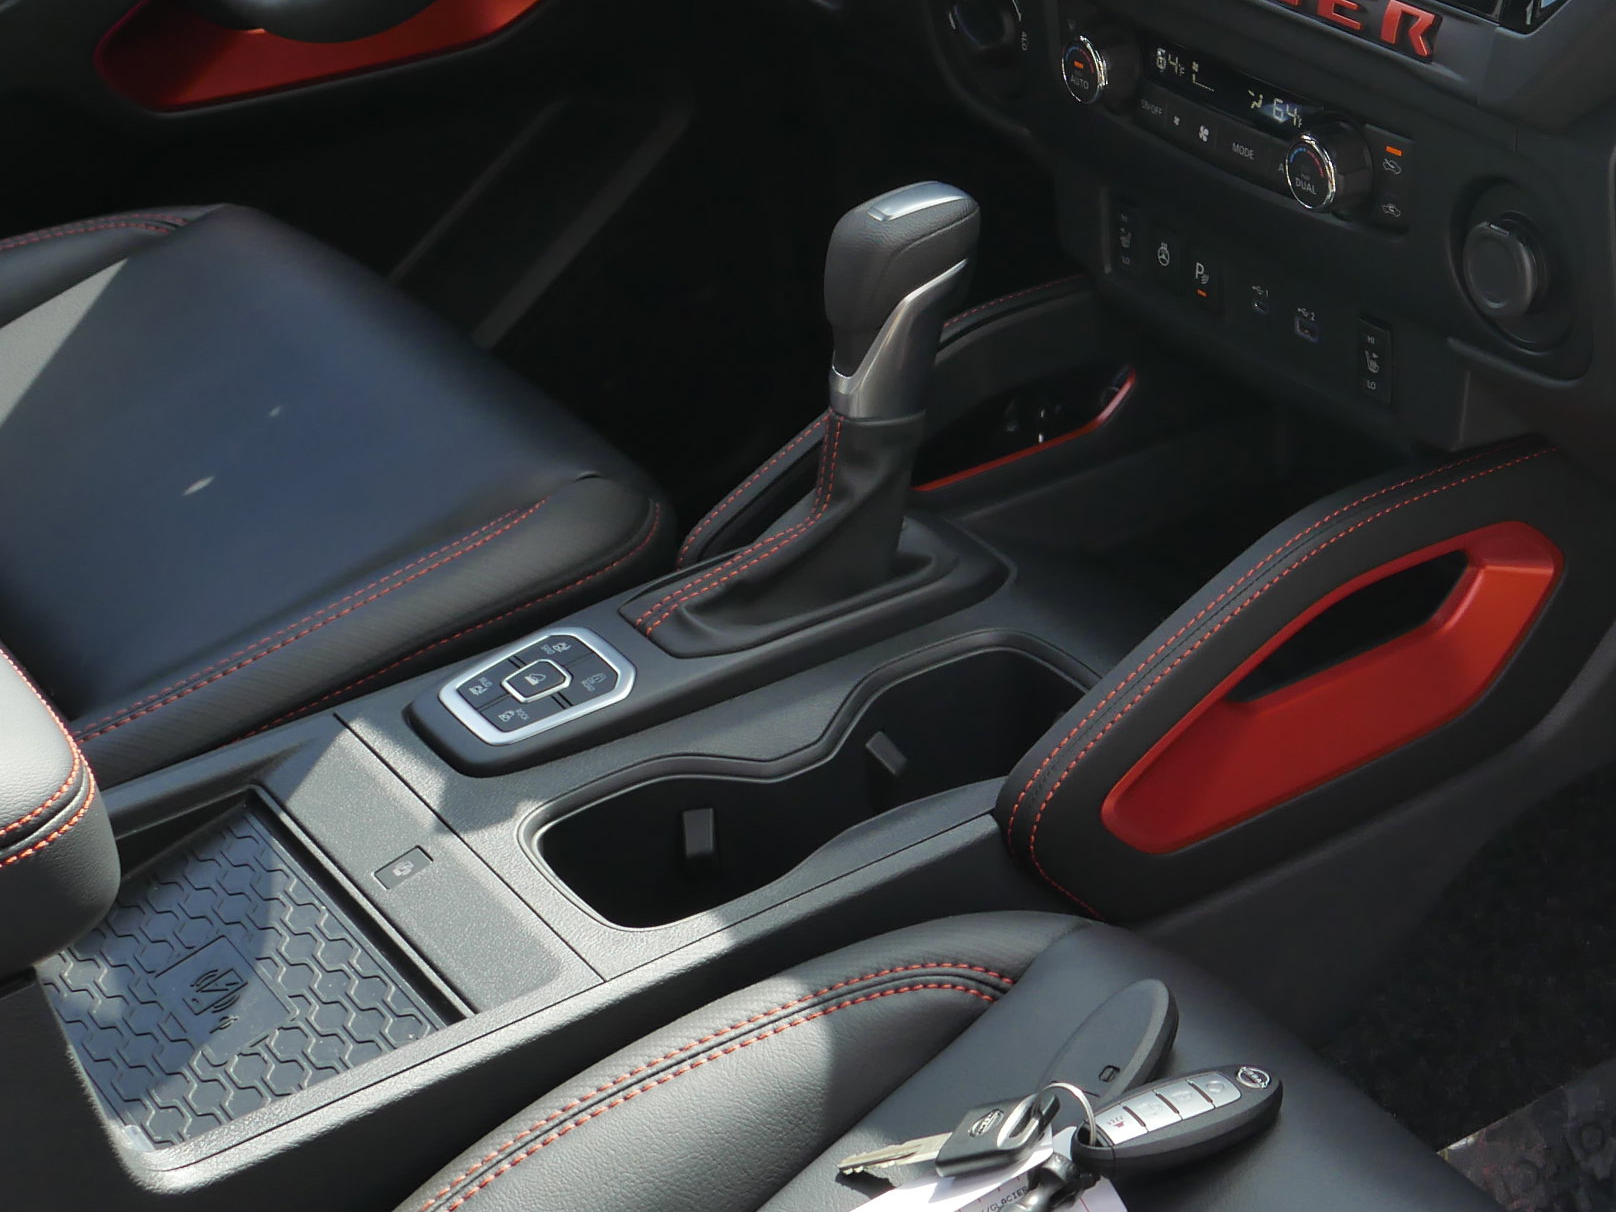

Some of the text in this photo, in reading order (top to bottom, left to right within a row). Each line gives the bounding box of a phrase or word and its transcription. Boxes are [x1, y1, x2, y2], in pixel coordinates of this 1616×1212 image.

[1070, 75, 1089, 89] AUTO
[1232, 142, 1254, 160] MODE
[1295, 177, 1317, 195] DUAL
